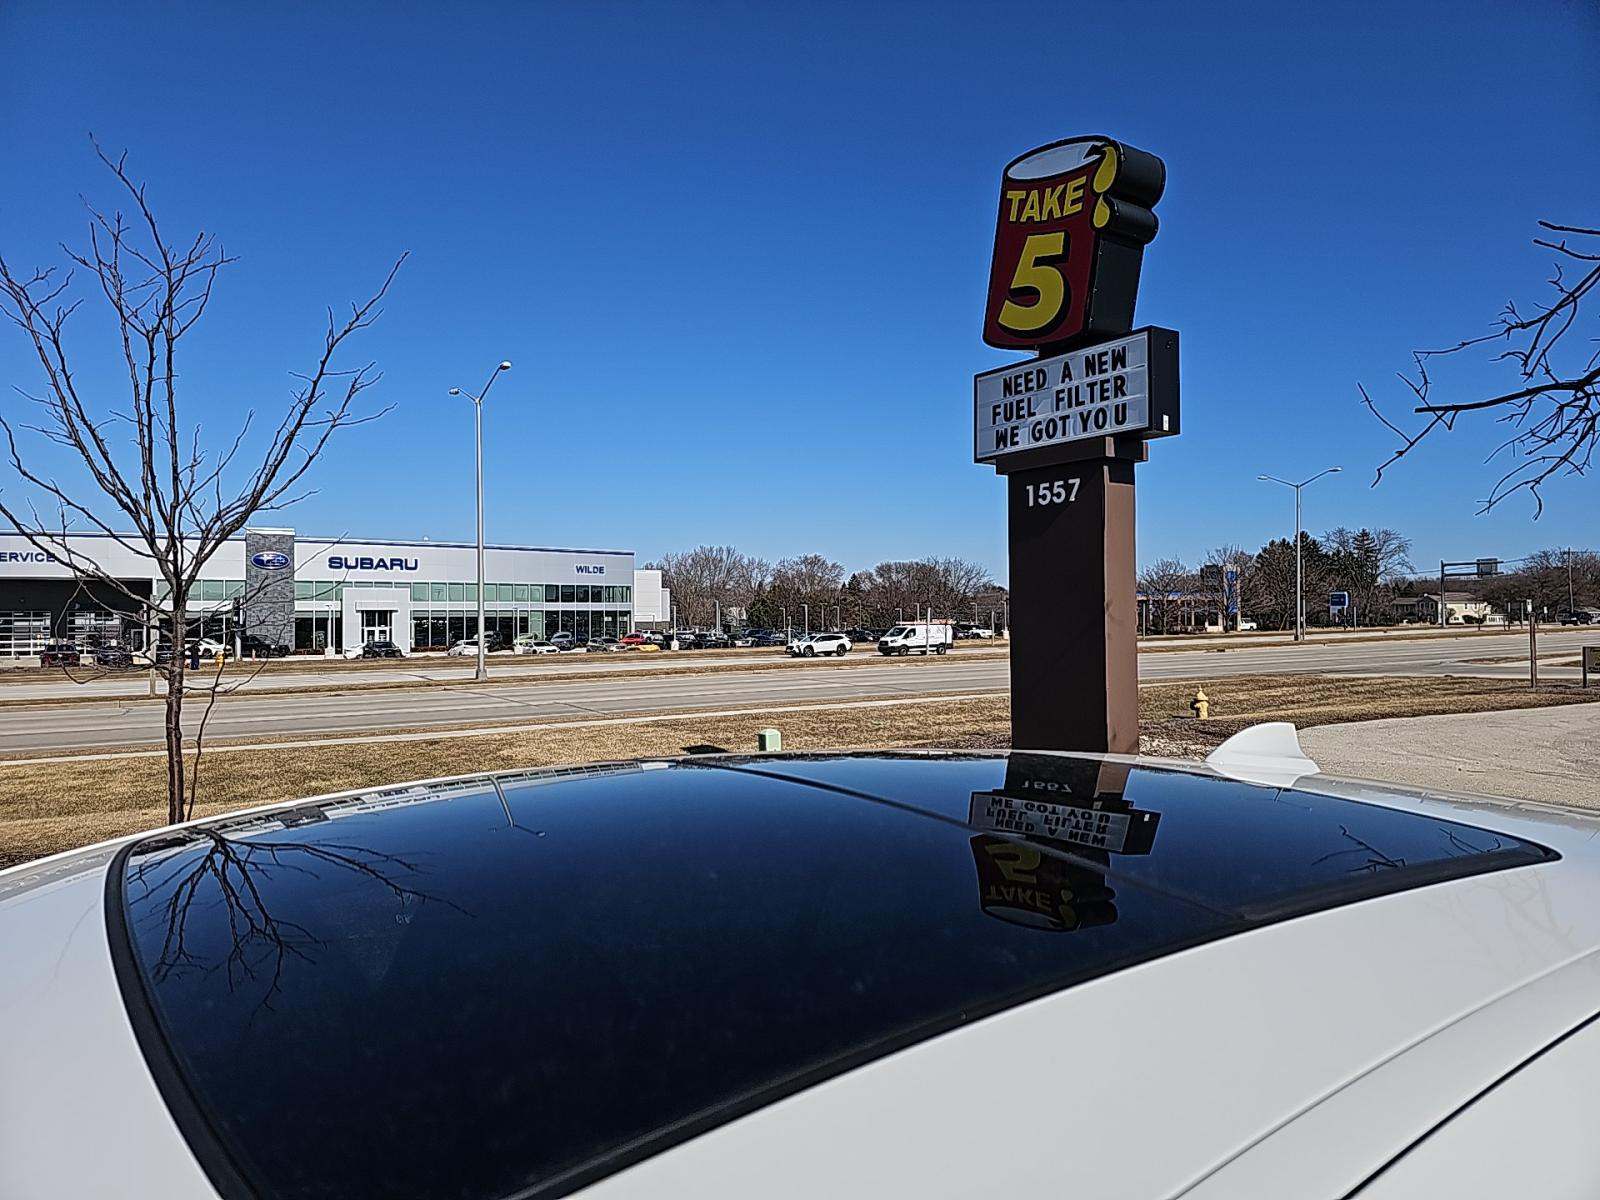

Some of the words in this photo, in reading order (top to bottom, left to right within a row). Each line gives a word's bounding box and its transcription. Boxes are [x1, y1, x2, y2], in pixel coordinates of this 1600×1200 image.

[1006, 175, 1086, 223] TAKE
[998, 232, 1065, 331] 5
[1002, 367, 1048, 398] NEED
[1061, 361, 1073, 384] A
[1084, 346, 1127, 378] NEW
[991, 397, 1037, 426] FUEL
[1055, 374, 1127, 411] FILTER
[995, 425, 1020, 450] WE
[1031, 415, 1071, 442] GOT
[1079, 403, 1128, 433] YOU
[1026, 477, 1081, 508] 1557
[328, 556, 419, 571] SUBARU
[575, 565, 605, 575] WILDE
